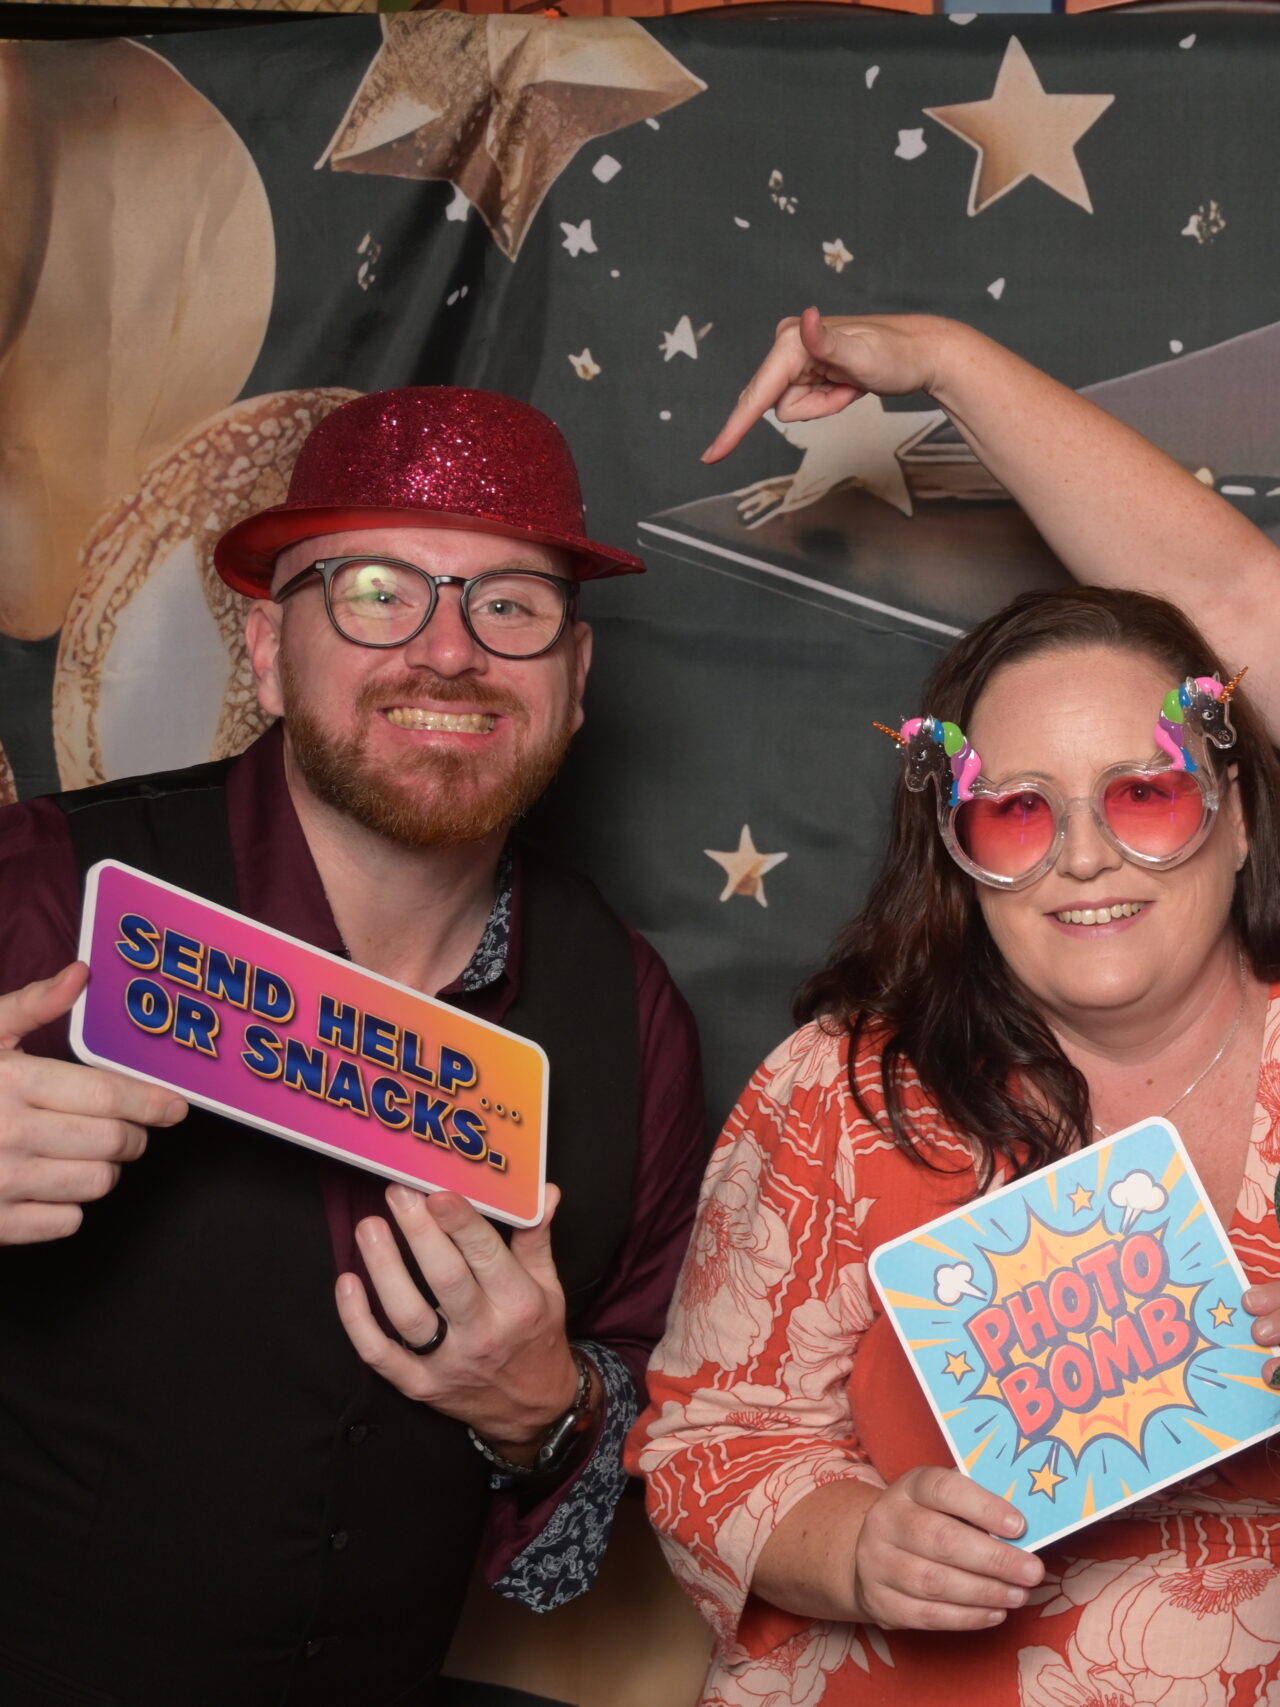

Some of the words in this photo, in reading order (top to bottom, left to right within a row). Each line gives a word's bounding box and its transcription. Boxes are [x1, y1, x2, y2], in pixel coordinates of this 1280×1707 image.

[115, 913, 296, 1024] SEND
[125, 977, 219, 1057] OR
[241, 1024, 508, 1172] SNACKS.
[965, 1232, 1169, 1373] PHOTO
[1000, 1297, 1192, 1436] BOMB
